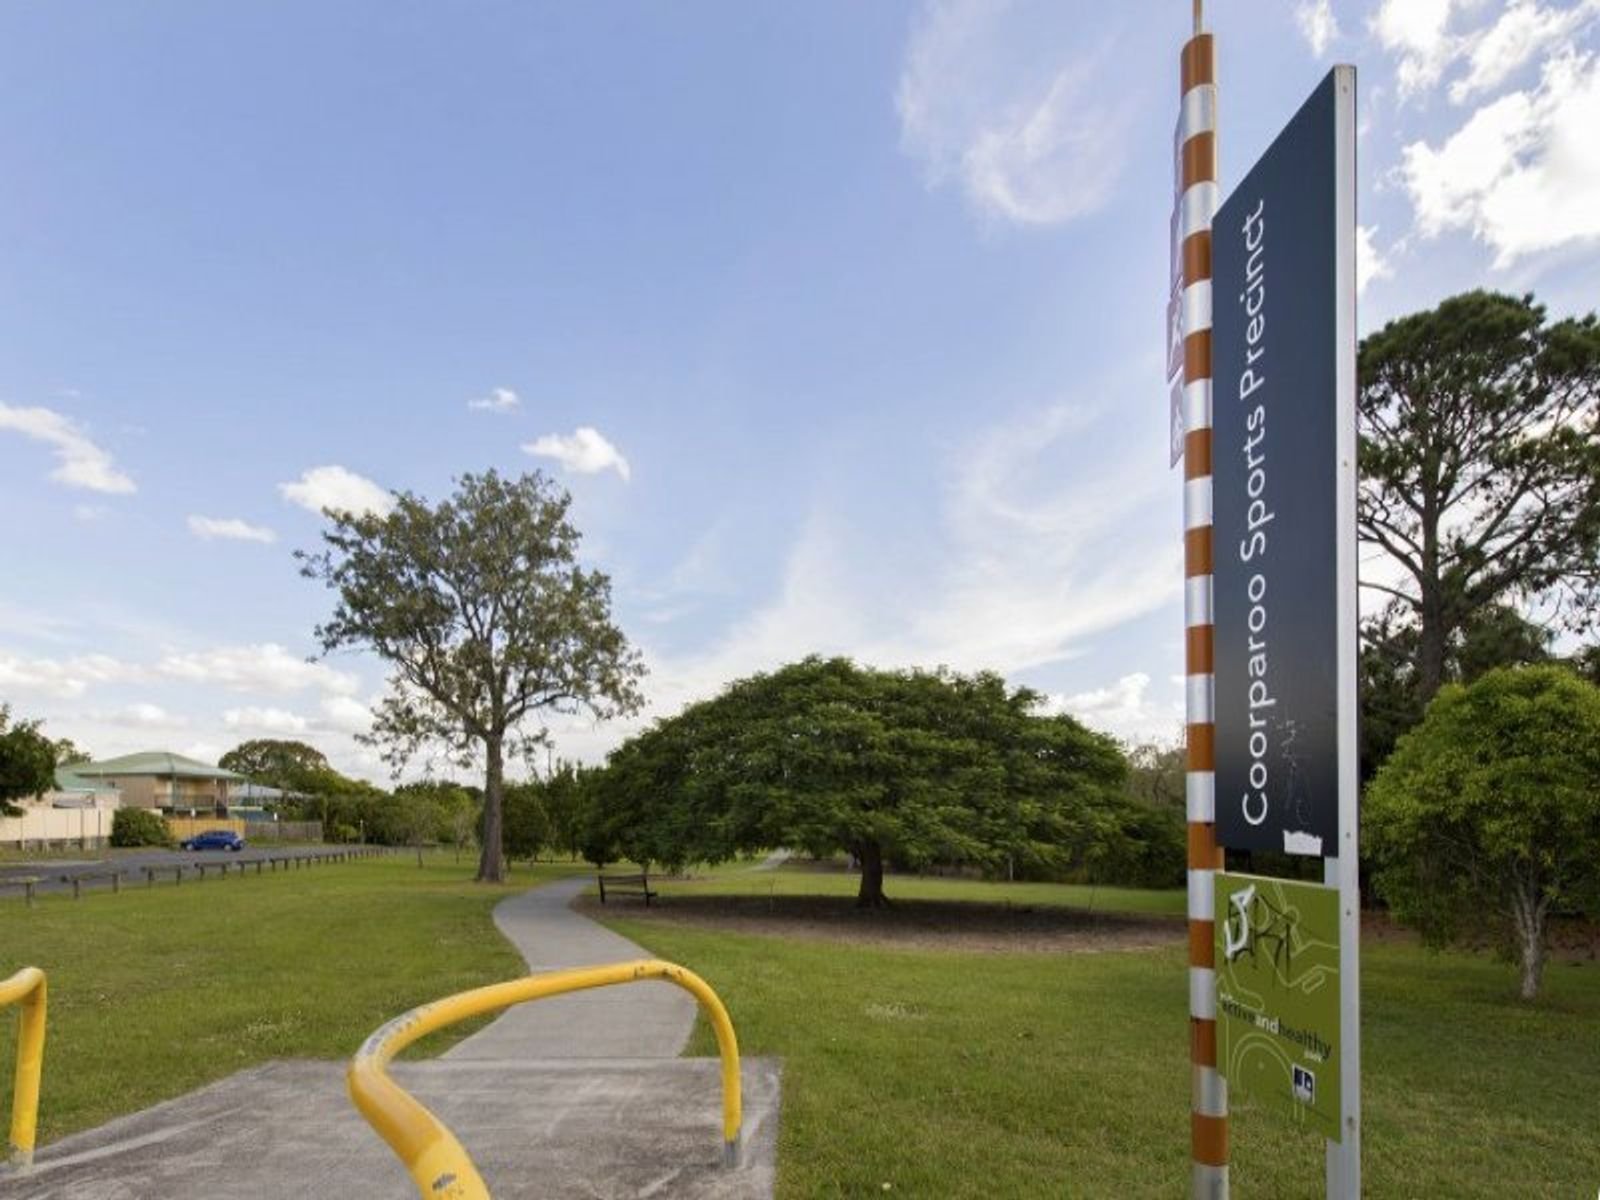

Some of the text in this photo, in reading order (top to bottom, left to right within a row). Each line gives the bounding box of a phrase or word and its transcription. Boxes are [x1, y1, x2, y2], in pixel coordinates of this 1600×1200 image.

[1239, 199, 1277, 825] Coorparoo Sports Precinct
